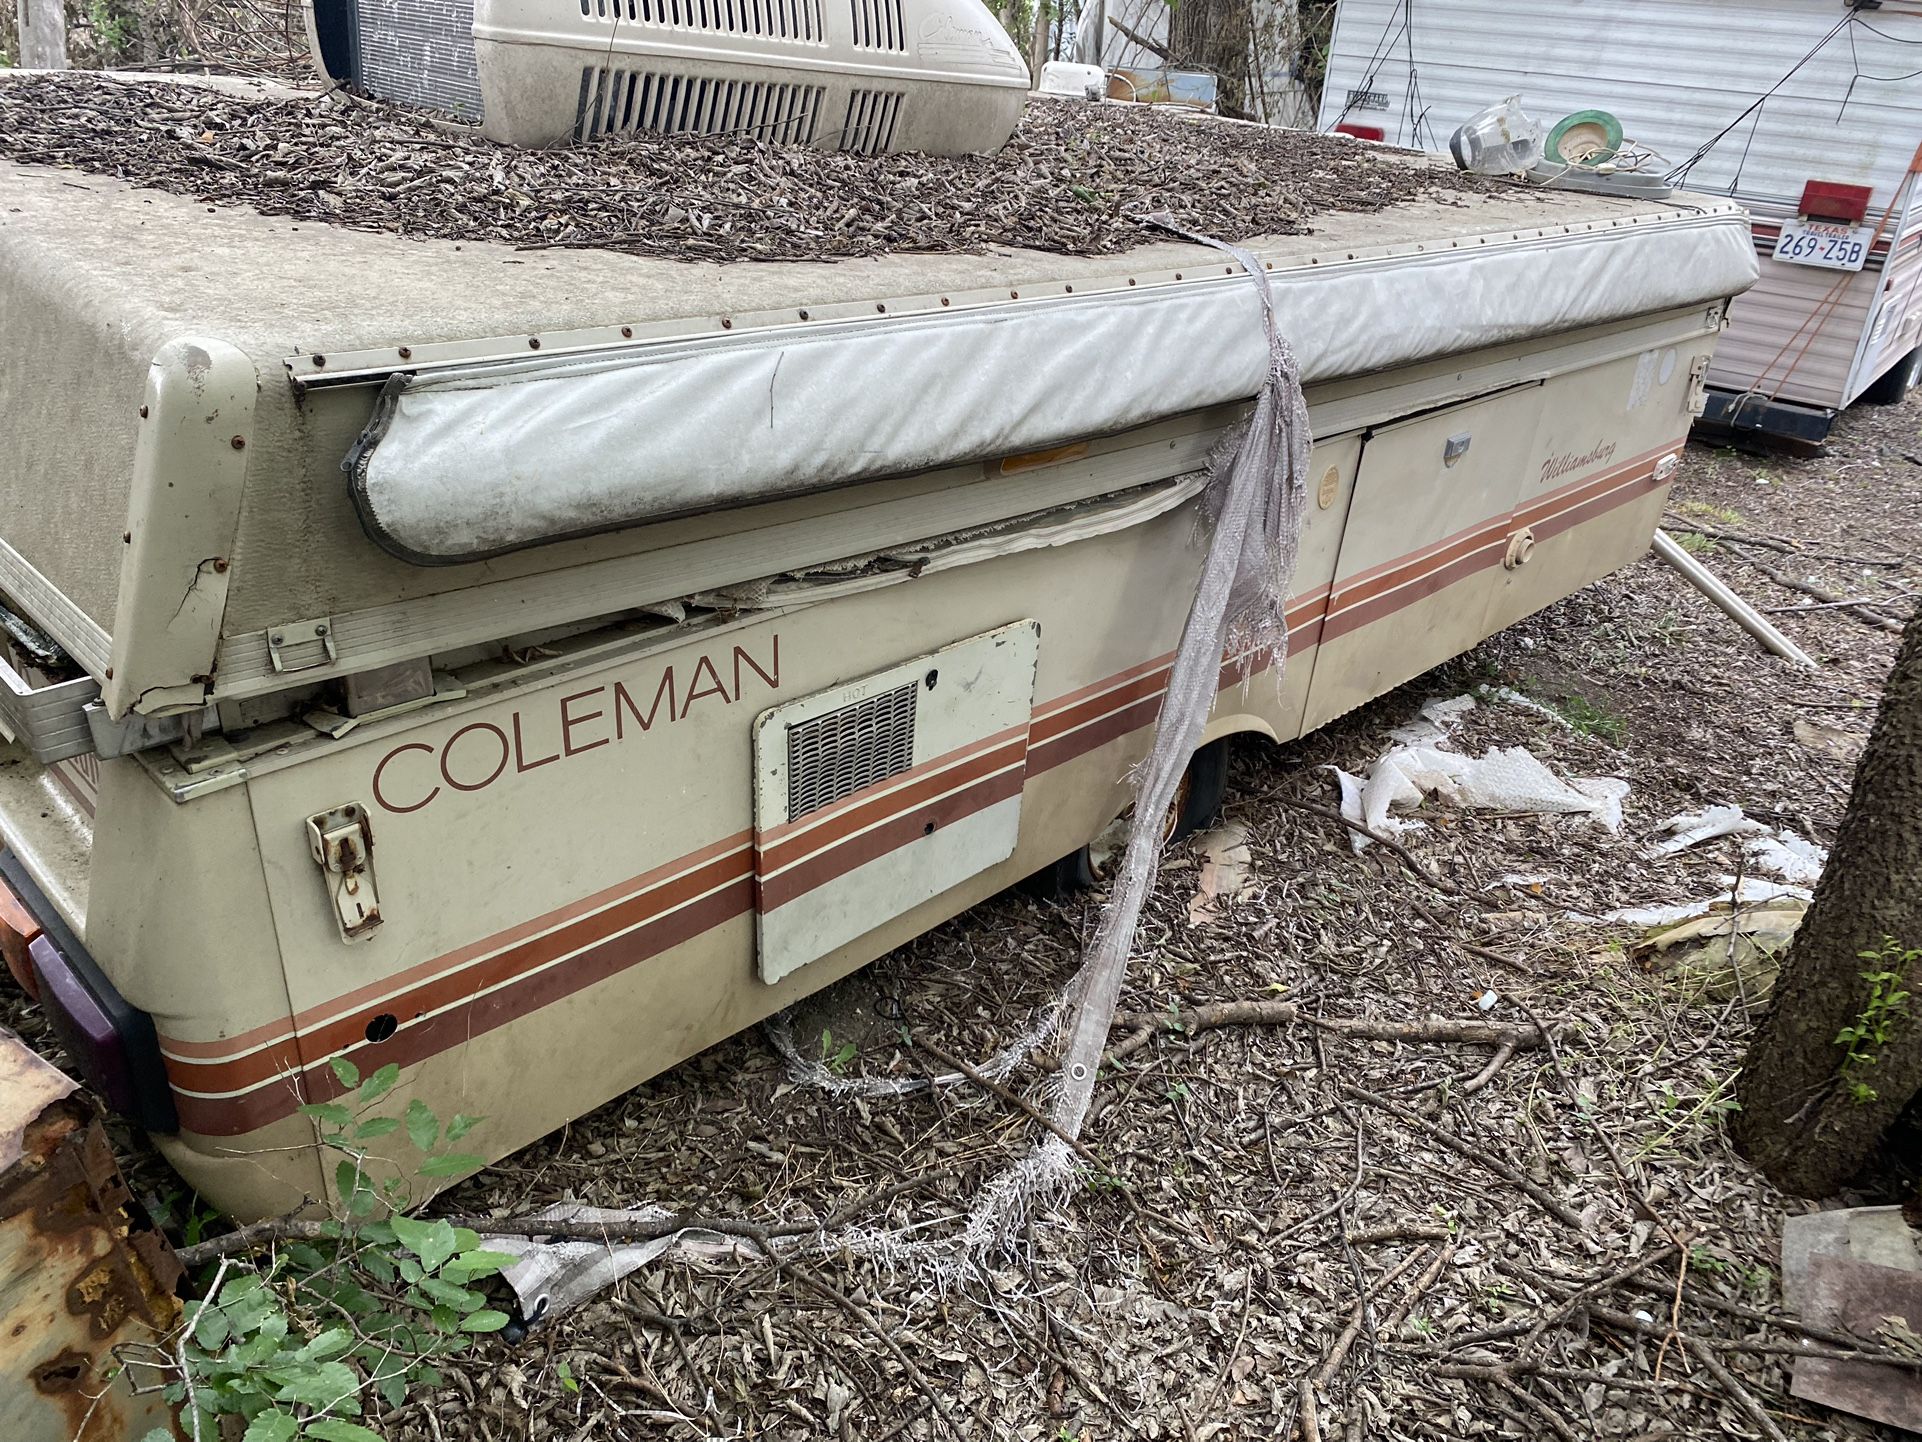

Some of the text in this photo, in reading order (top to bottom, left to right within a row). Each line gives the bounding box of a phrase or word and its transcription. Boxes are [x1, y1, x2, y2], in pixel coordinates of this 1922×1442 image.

[1808, 223, 1848, 234] TEXAS
[1540, 438, 1616, 484] Williamsburg
[843, 684, 868, 702] HOT
[372, 634, 779, 813] COLEMAN
